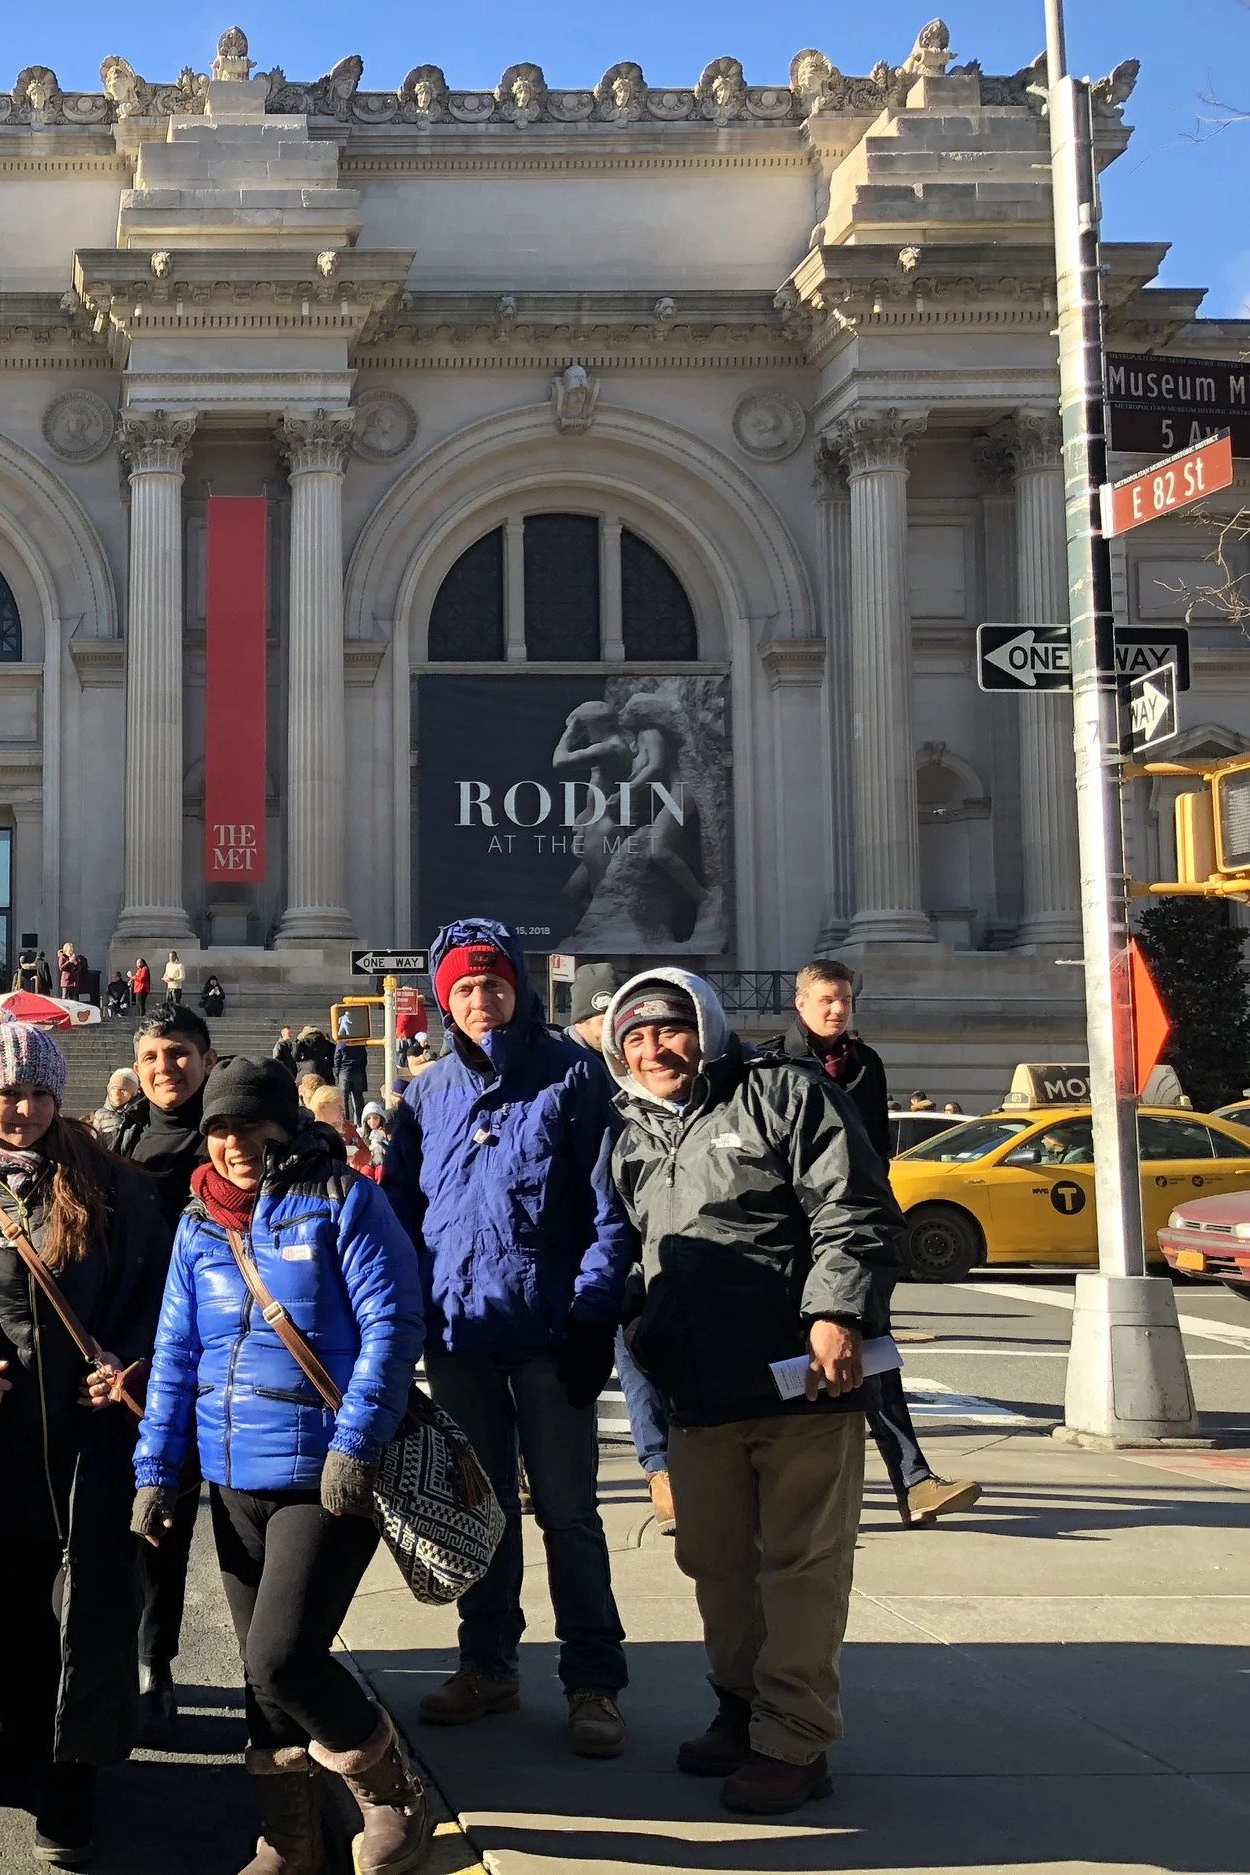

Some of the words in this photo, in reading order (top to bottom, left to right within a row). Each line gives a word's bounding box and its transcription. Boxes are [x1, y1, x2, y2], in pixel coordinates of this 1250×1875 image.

[1109, 365, 1216, 402] Museum
[1230, 374, 1250, 404] M
[1161, 419, 1174, 449] 5
[1132, 486, 1143, 520] E
[1153, 471, 1176, 510] 82
[1183, 456, 1205, 497] St
[1008, 645, 1070, 671] ONE
[454, 780, 690, 828] RODIN
[213, 824, 256, 846] THE
[487, 835, 517, 854] AT
[533, 835, 584, 854] THE
[603, 835, 660, 855] MET
[212, 848, 258, 870] MET
[515, 926, 527, 936] 15,
[528, 926, 551, 935] 2018
[363, 957, 385, 968] ONE
[395, 957, 419, 968] WAY
[1032, 1187, 1050, 1195] NYC
[1057, 1187, 1078, 1211] T
